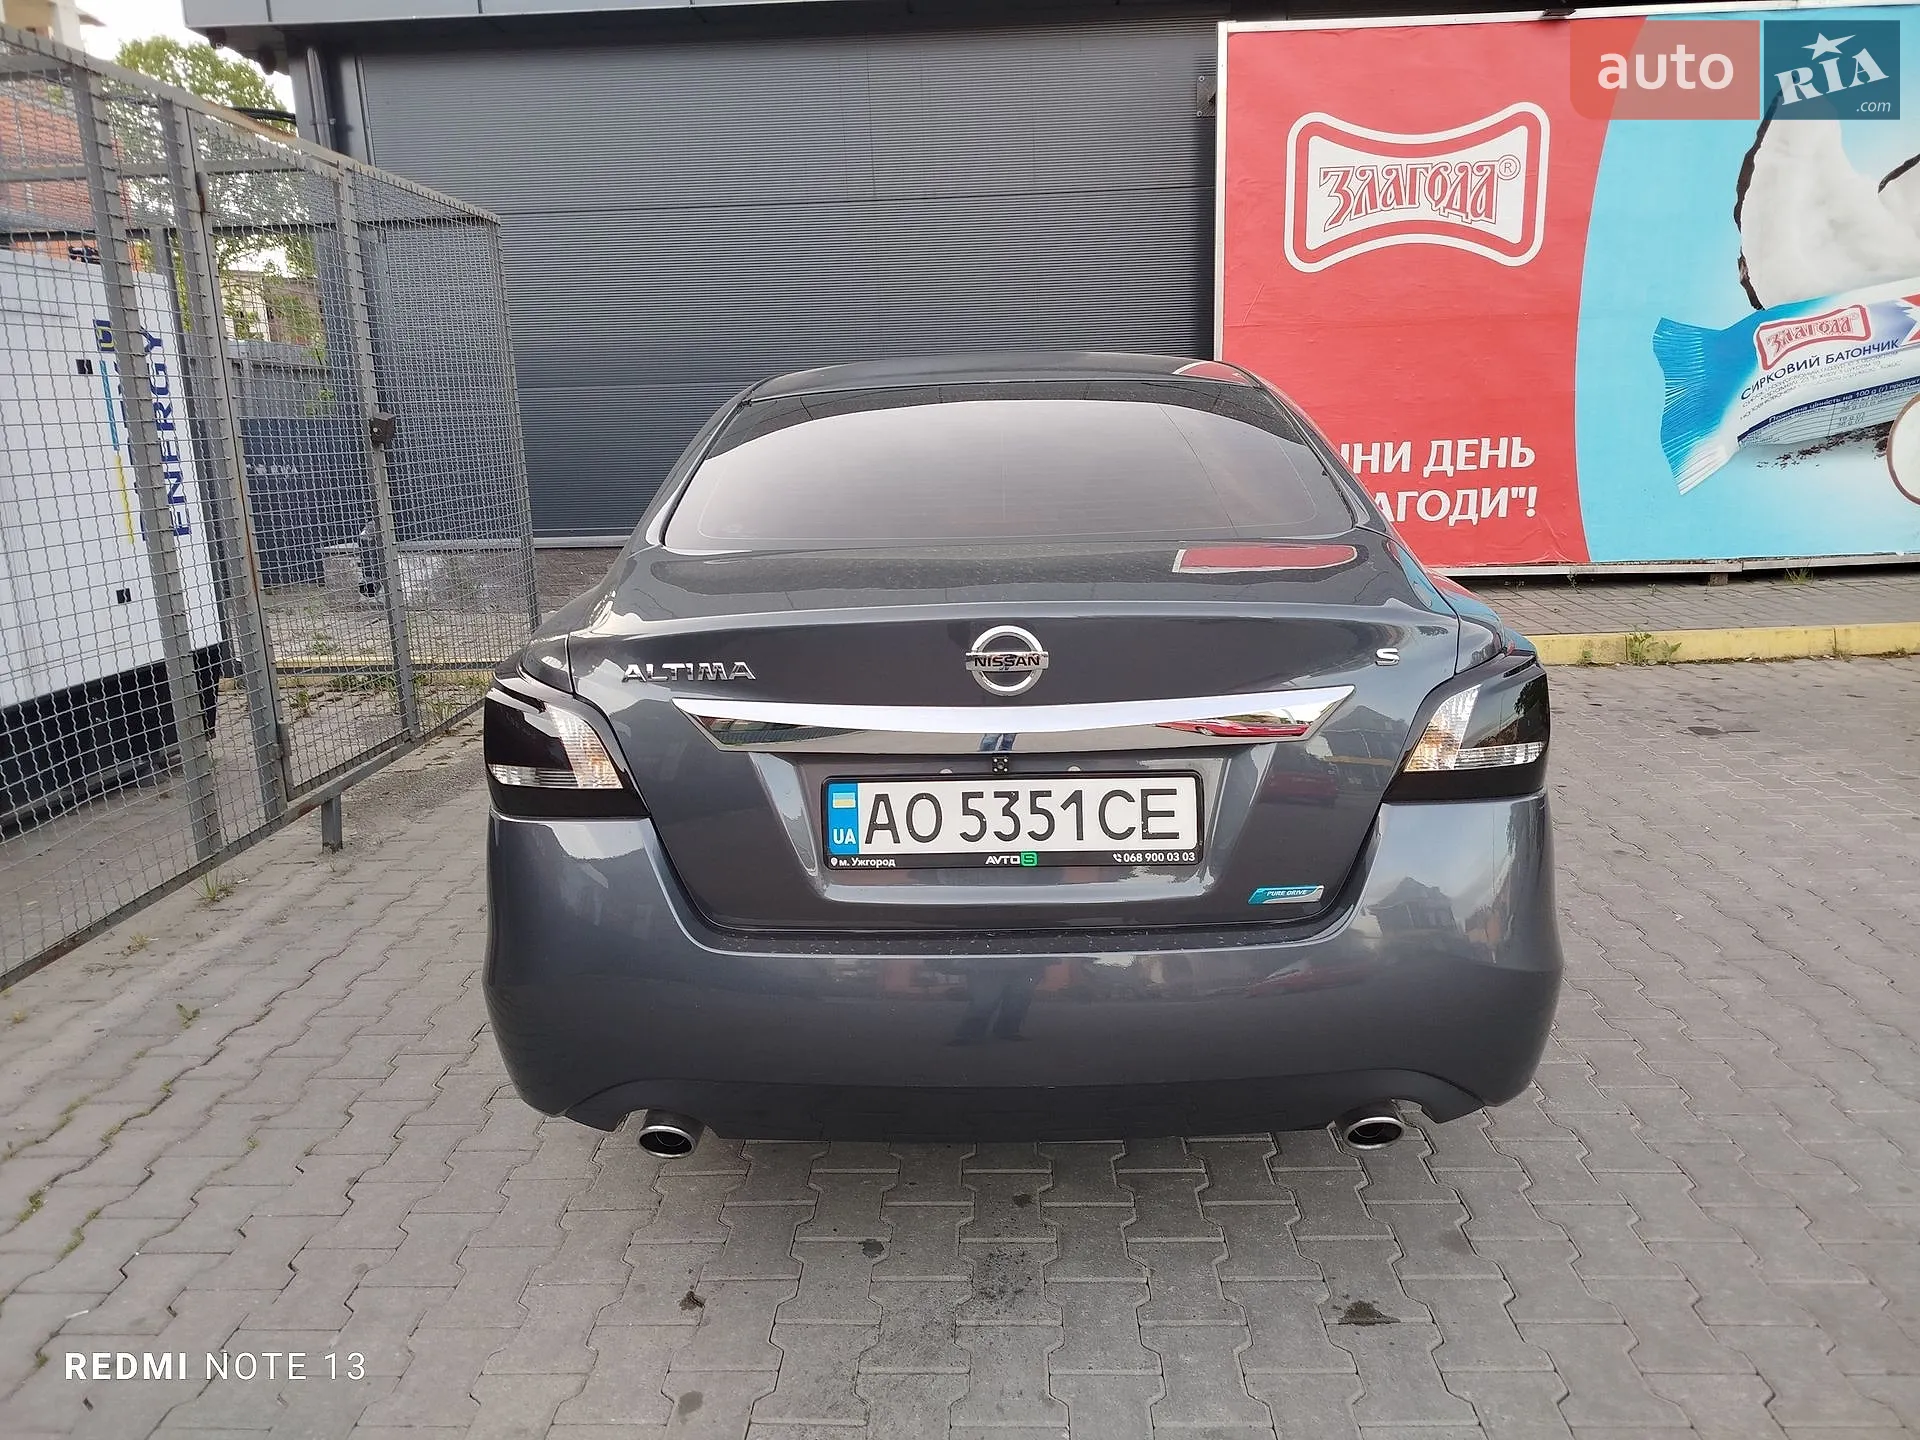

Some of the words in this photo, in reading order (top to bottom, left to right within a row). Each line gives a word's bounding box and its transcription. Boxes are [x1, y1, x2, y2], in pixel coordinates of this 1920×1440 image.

[1319, 161, 1499, 232] ЗЛАГОДА
[1766, 314, 1854, 353] ЗЛАГОДА
[1741, 354, 1821, 400] СИРКОВИЙ
[1825, 338, 1899, 365] БАТОНЧИК
[139, 326, 192, 536] ENERGY
[1423, 436, 1536, 478] ДЕНЬ
[622, 661, 756, 682] ALTIMA
[974, 655, 1040, 667] NISSAN
[1375, 647, 1400, 666] S
[864, 792, 943, 844] AO
[959, 789, 1085, 843] 5351
[1098, 788, 1180, 841] CE
[833, 828, 857, 845] UA
[851, 857, 896, 868] Ужгород
[1123, 853, 1143, 863] 068
[1145, 853, 1164, 863] 900
[1166, 853, 1180, 862] 03
[1182, 852, 1196, 862] 03
